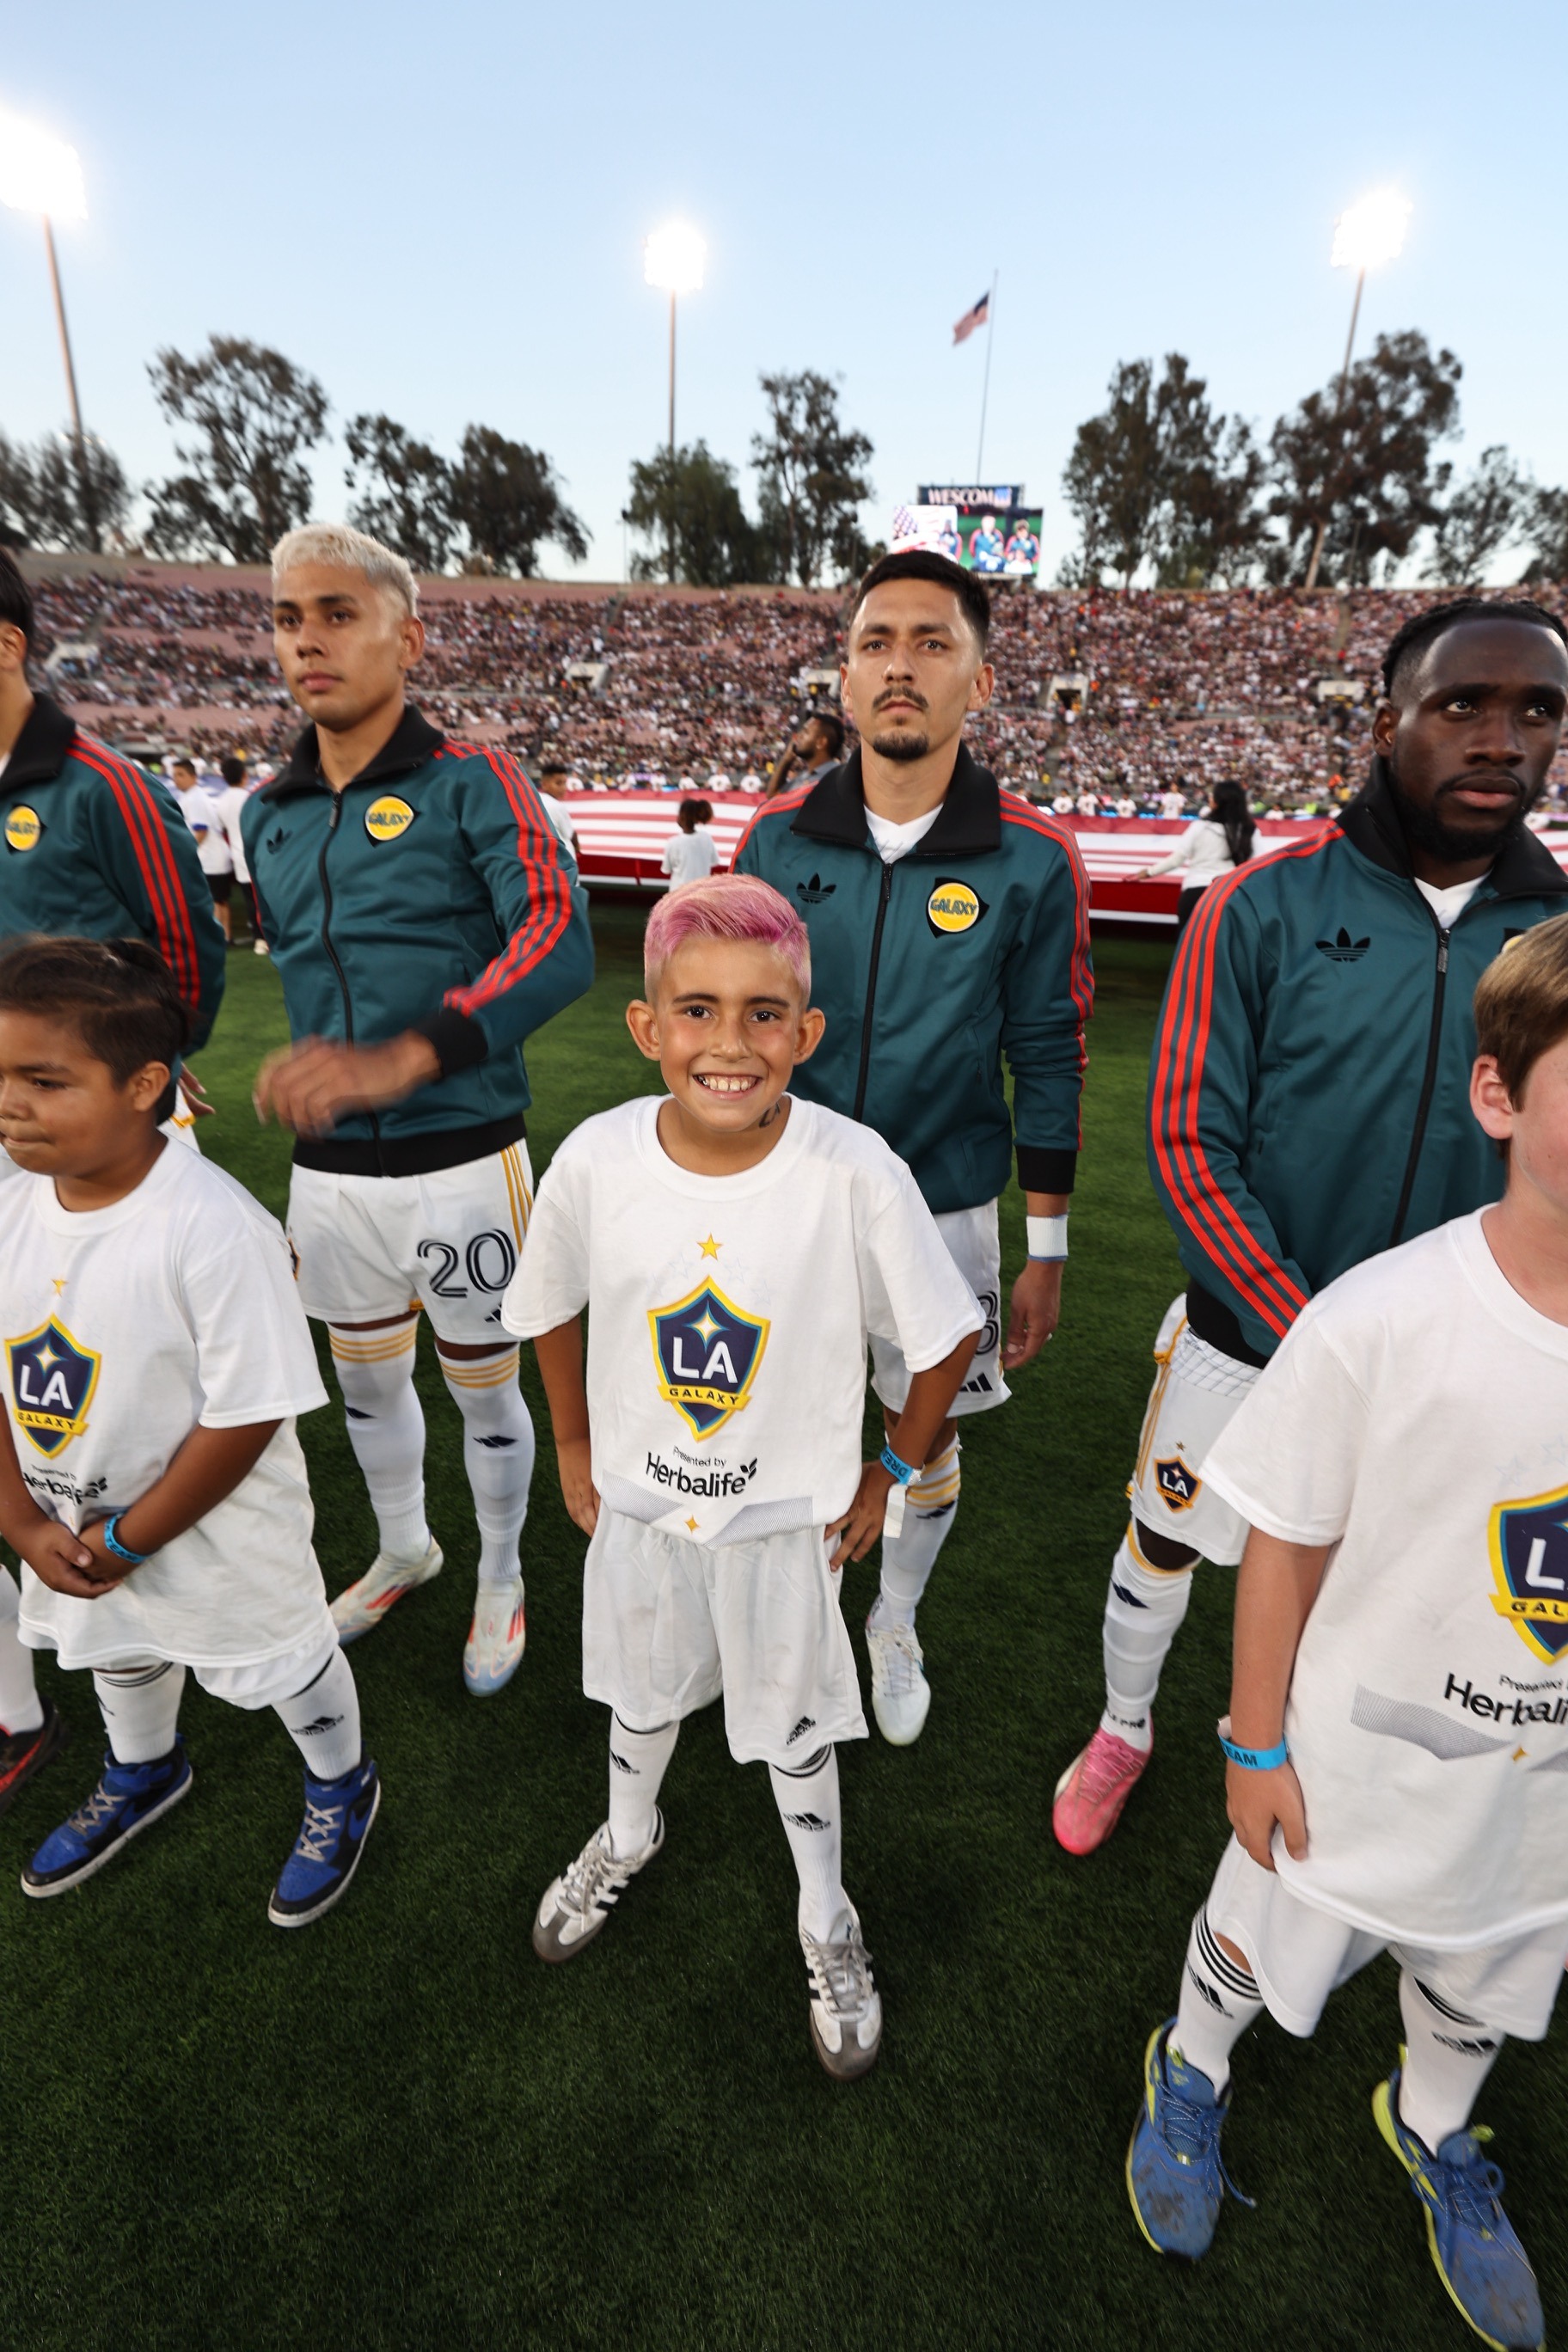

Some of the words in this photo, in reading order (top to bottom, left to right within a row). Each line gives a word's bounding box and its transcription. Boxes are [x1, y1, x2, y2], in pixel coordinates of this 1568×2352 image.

[928, 487, 995, 505] WESCOM
[930, 898, 977, 916] GALAXY
[417, 1228, 516, 1299] 20
[672, 1336, 738, 1384] LA
[19, 1363, 74, 1411] LA
[669, 1387, 739, 1406] GALAXY
[17, 1411, 76, 1430] GALAXY
[646, 1451, 747, 1498] Herbalife
[714, 1456, 727, 1469] by
[1162, 1470, 1189, 1498] LA
[1525, 1536, 1568, 1591] L
[1511, 1601, 1568, 1617] GAL
[1443, 1671, 1568, 1726] Herbali
